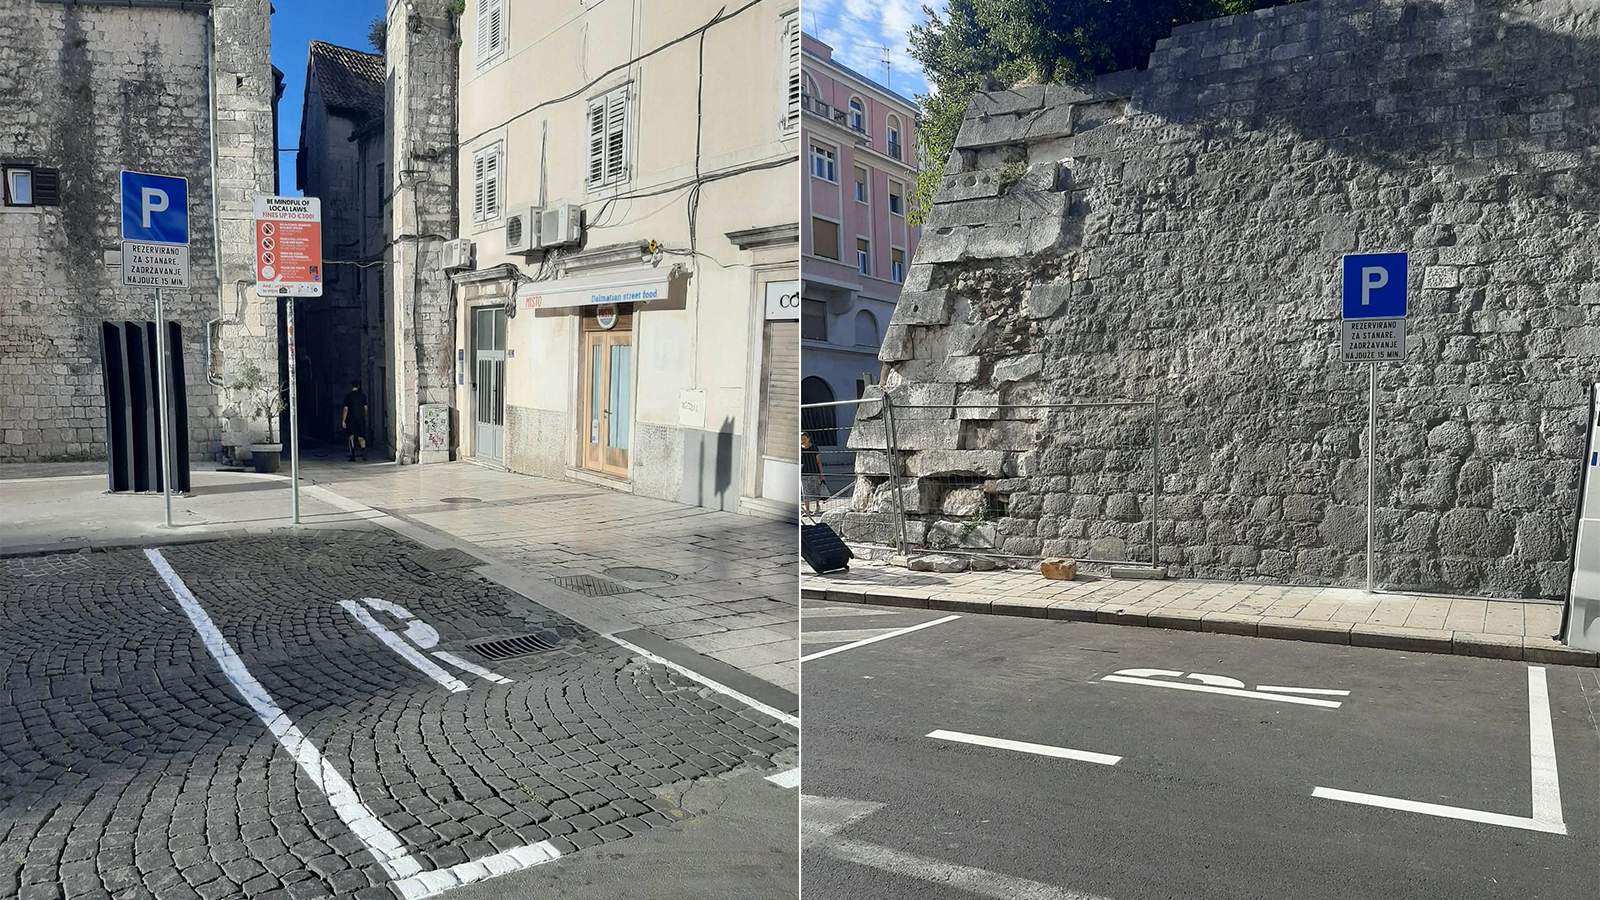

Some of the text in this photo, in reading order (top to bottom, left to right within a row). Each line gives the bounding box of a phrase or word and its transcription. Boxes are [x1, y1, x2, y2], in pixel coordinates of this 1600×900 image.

[141, 187, 170, 228] P
[132, 244, 180, 256] REZERVIRANO
[132, 255, 180, 266] ZA STANARE.
[161, 277, 169, 286] 15
[171, 277, 186, 287] MIN.
[1361, 265, 1389, 306] P
[591, 288, 658, 304] Dalmatian street food
[525, 296, 542, 308] MISTO
[1351, 321, 1397, 330] REZERVIRANO
[1351, 331, 1396, 340] ZA STANARE.
[1386, 350, 1401, 358] MIN.
